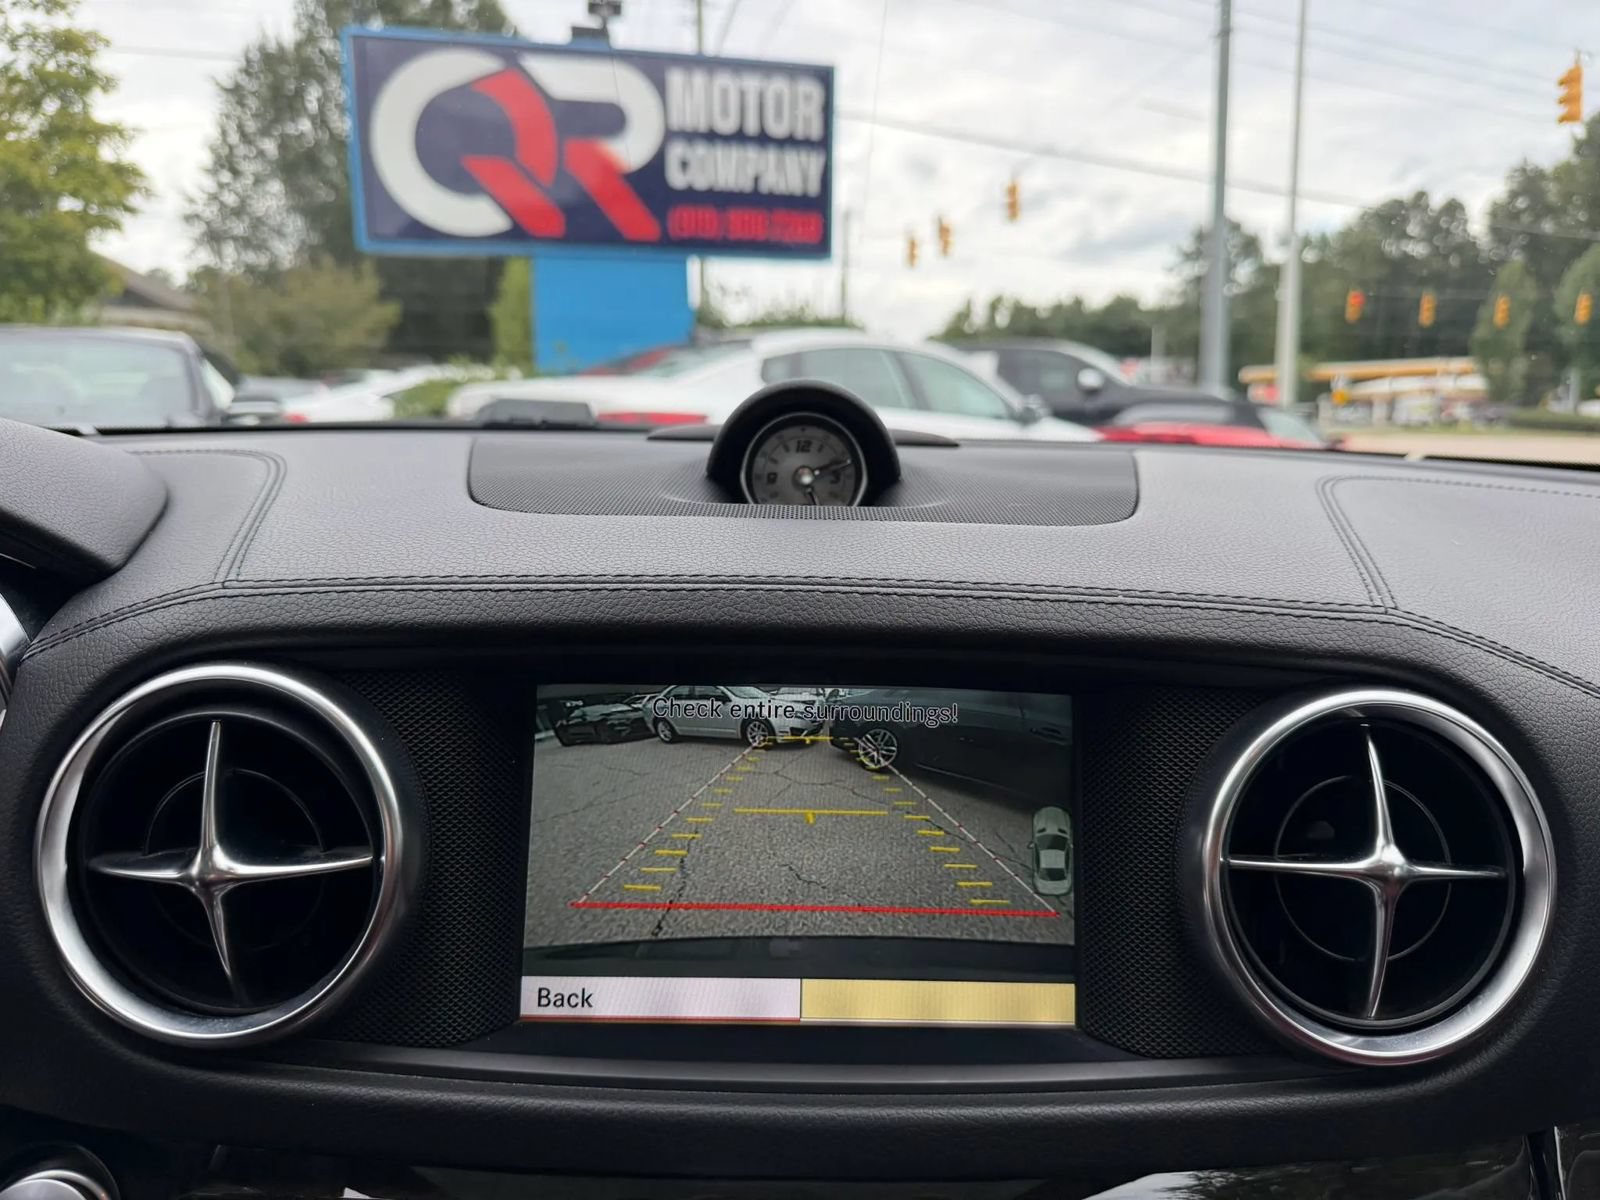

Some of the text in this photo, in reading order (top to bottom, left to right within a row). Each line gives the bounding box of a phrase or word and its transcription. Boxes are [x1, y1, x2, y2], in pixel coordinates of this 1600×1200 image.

[665, 67, 825, 141] MOTOR
[664, 137, 827, 197] COMPANY
[796, 440, 812, 453] 12
[652, 697, 959, 728] Check entire surroundings!
[537, 987, 593, 1009] Back
